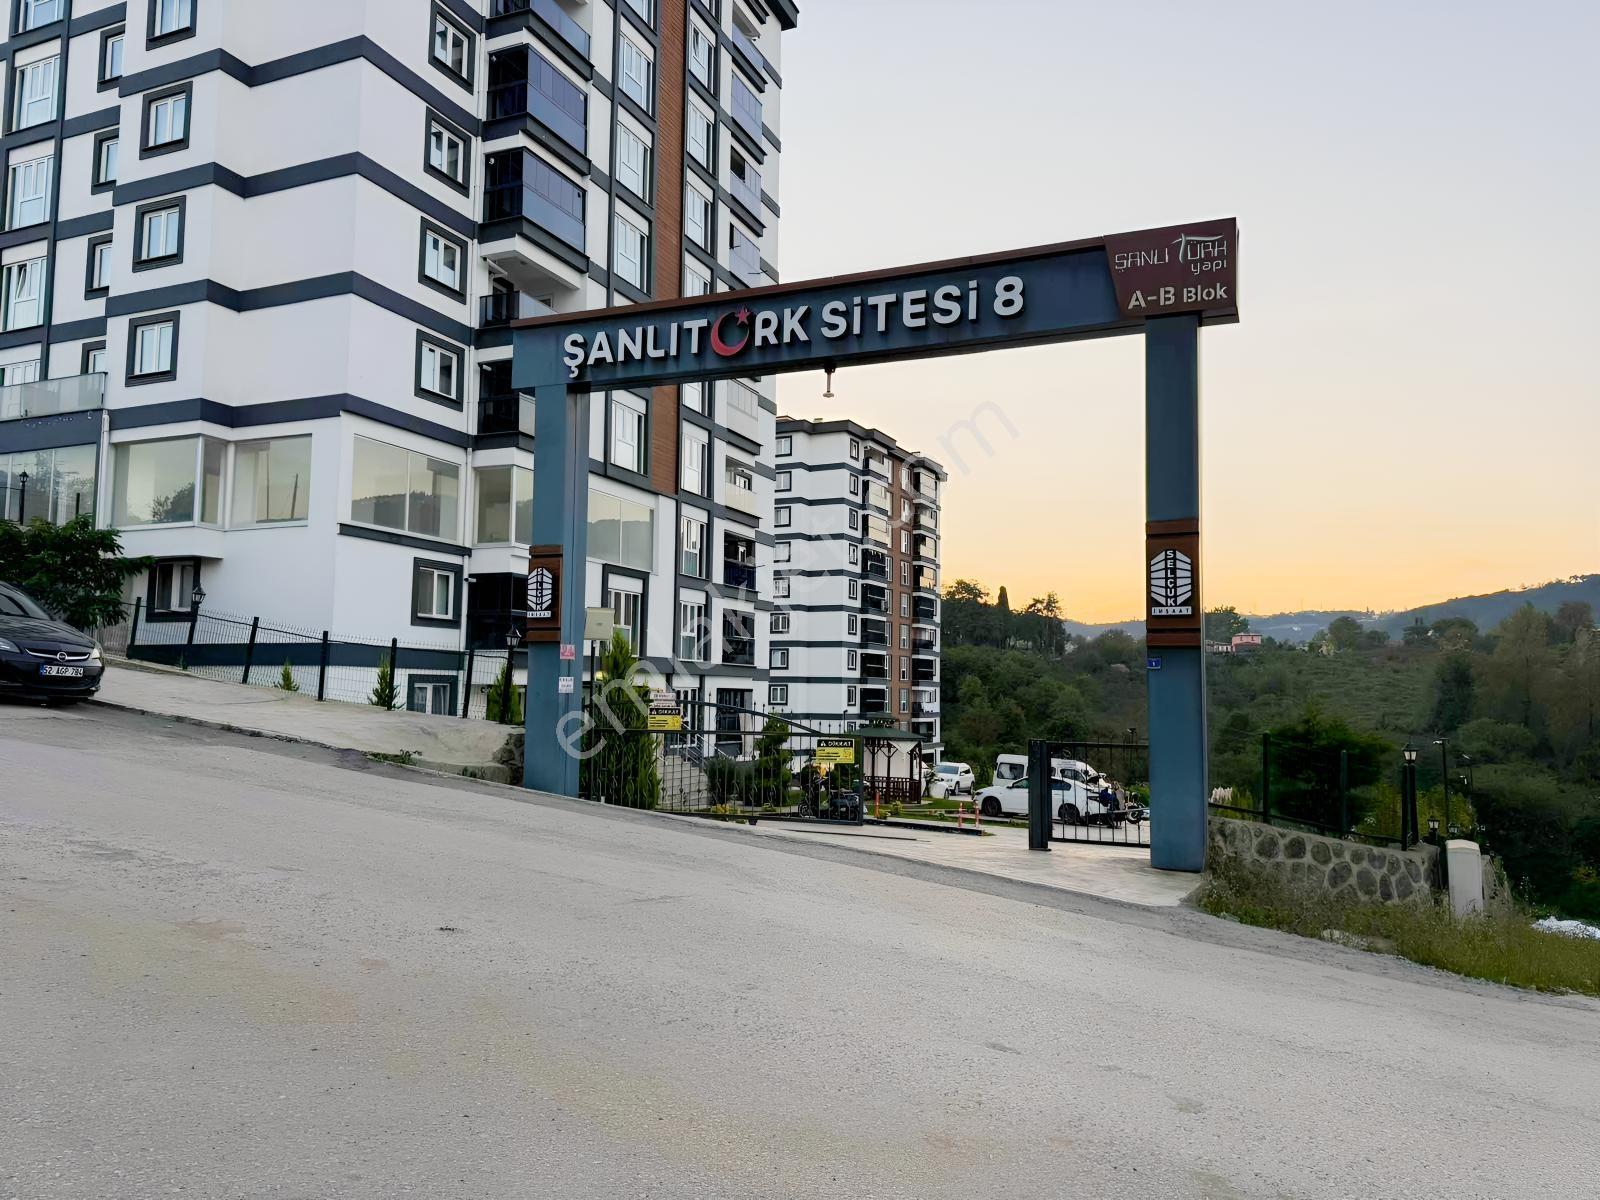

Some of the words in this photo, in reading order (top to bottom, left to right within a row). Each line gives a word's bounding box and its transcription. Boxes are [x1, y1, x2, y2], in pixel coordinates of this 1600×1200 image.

[993, 275, 1025, 317] 8
[1127, 286, 1175, 310] A-B
[1183, 283, 1228, 303] Blok
